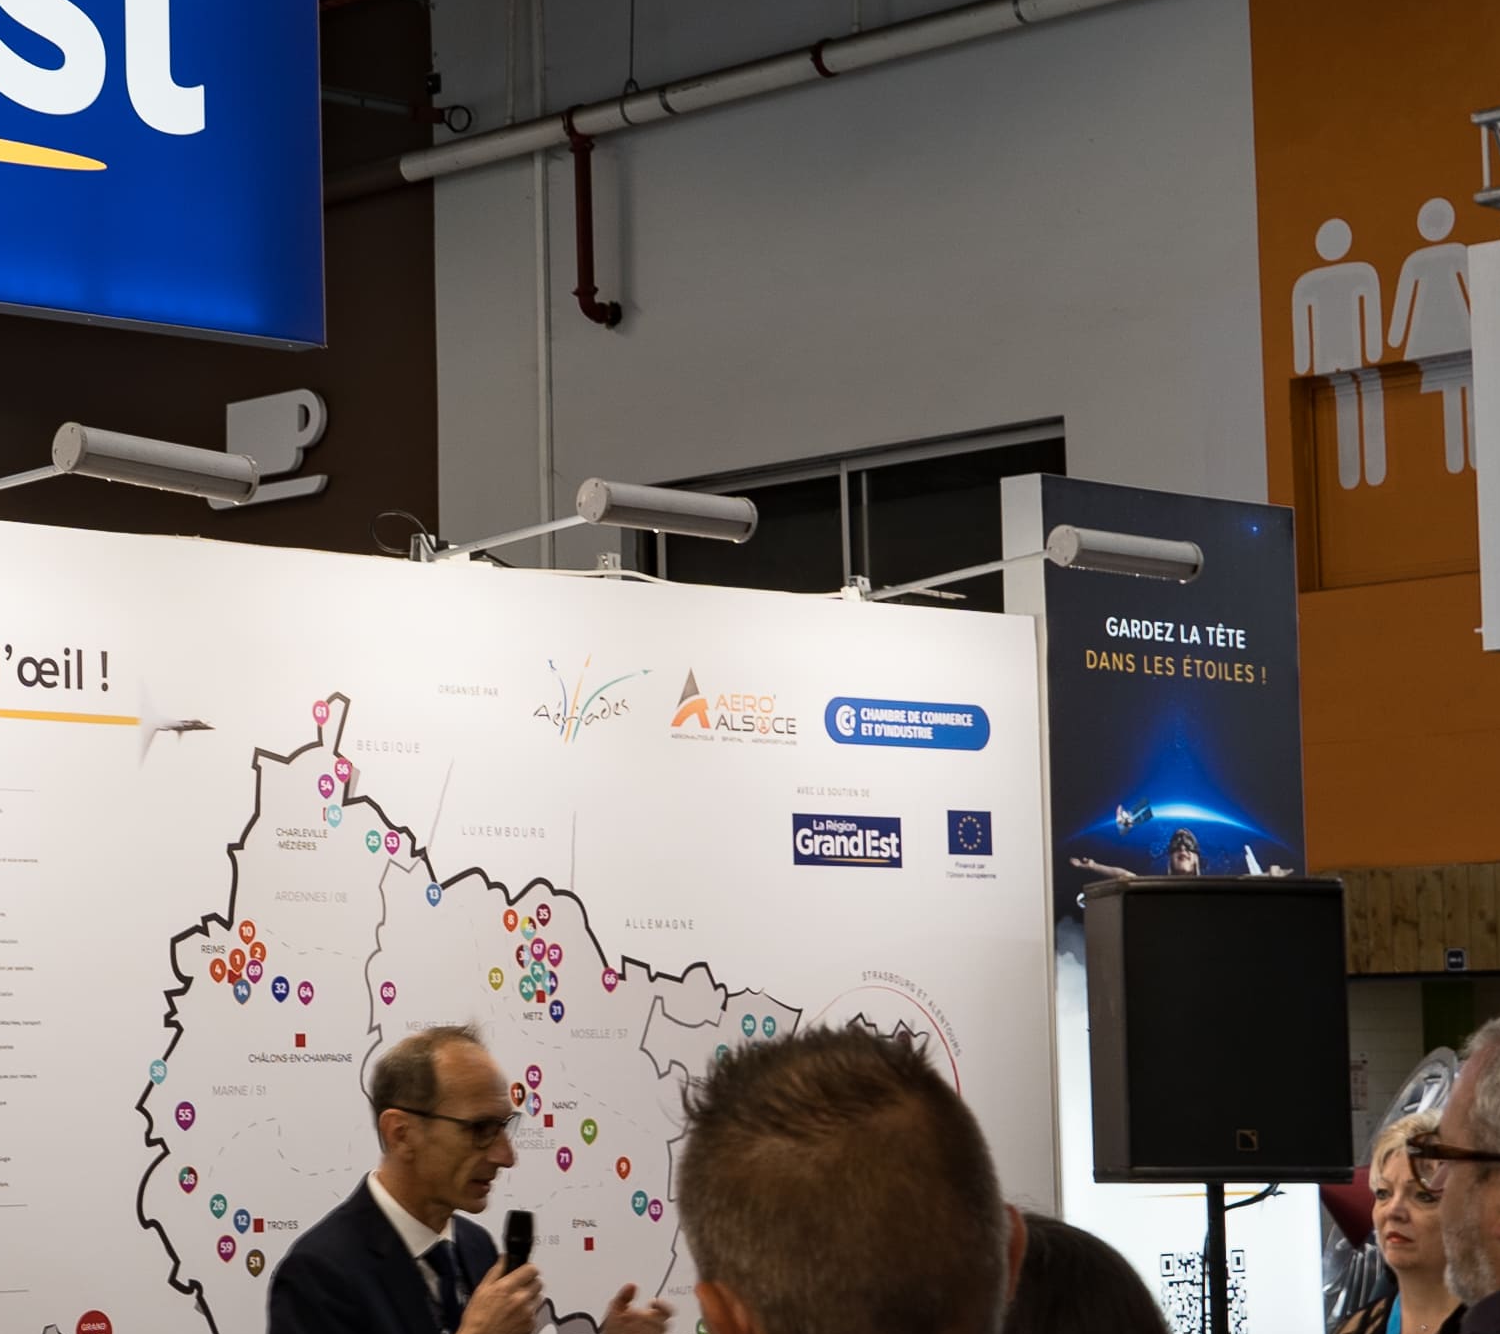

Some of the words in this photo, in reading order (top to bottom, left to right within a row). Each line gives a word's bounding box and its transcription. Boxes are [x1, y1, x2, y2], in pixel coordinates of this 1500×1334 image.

[1106, 616, 1175, 642] GARDEZ
[1180, 624, 1201, 645] LA
[1206, 623, 1246, 649] TÊTE
[98, 649, 111, 692] !
[1085, 649, 1136, 674] DANS
[1143, 655, 1175, 676] LES
[1183, 654, 1254, 684] ÉTOILES
[1261, 666, 1267, 685] !
[316, 707, 326, 717] 61
[861, 708, 906, 723] CHAMBRE
[907, 710, 921, 723] DE
[922, 711, 973, 727] COMMERCE
[861, 723, 873, 736] ET
[357, 740, 420, 754] BELGIQUE
[321, 780, 332, 790] 54
[813, 820, 824, 831] La
[826, 820, 856, 833] Région
[276, 828, 328, 838] CHARLEVILLE
[462, 826, 546, 838] LUXEMBOURG
[368, 836, 380, 846] 25
[387, 838, 398, 848] 53
[796, 829, 862, 857] Grand
[866, 830, 900, 858] Est
[275, 891, 327, 902] ARDENNES
[625, 919, 694, 930] ALLEMAGNE
[242, 926, 253, 936] 10
[201, 945, 225, 954] REIMS
[862, 971, 916, 993] STRASBOURG
[237, 986, 248, 996] 14
[275, 983, 287, 993] 32
[300, 987, 312, 998] 64
[524, 1012, 542, 1021] METZ
[571, 1029, 609, 1039] MOSELLE
[249, 1053, 352, 1063] CHÂLONS-EN-CHAMPAGNE
[212, 1086, 248, 1096] MARNE
[552, 1101, 577, 1109] NANCY
[179, 1109, 192, 1120] 55
[267, 1221, 298, 1229] TROYES
[81, 1323, 106, 1331] GRAND
